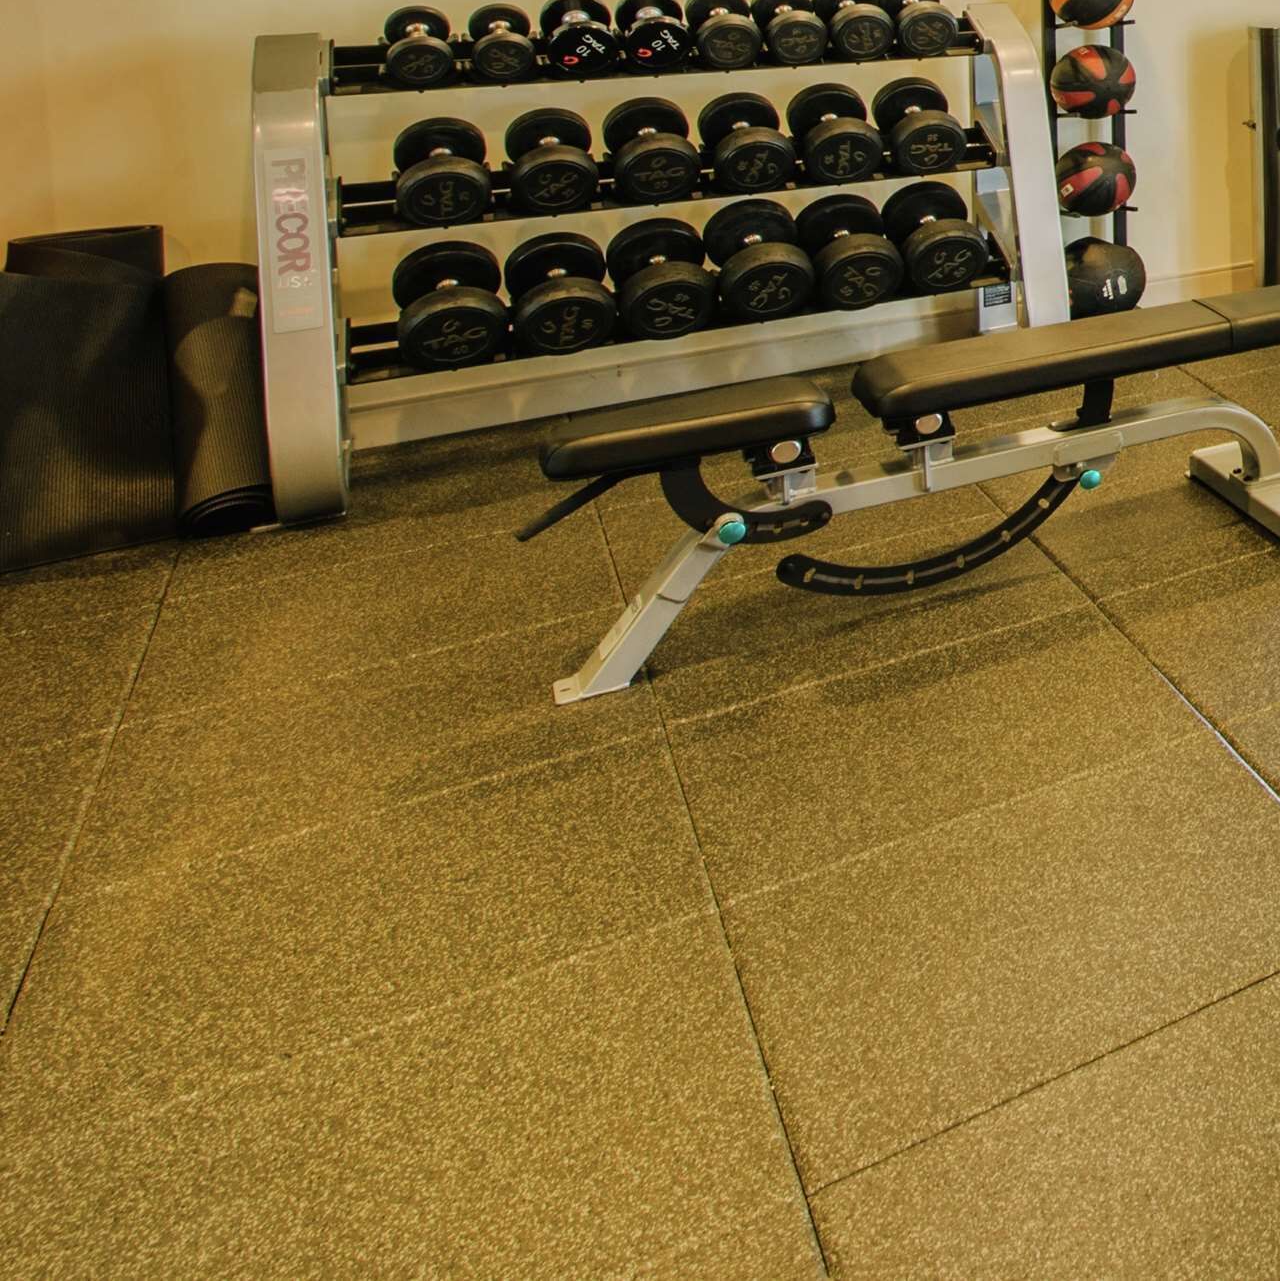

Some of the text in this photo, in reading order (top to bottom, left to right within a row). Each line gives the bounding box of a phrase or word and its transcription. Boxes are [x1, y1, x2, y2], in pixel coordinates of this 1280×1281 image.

[582, 34, 606, 54] TAG
[651, 39, 666, 51] 10
[660, 29, 681, 50] TAG
[576, 45, 592, 57] 10
[838, 141, 851, 175] TAG
[911, 142, 953, 155] TAG
[634, 169, 686, 184] TAG
[927, 249, 973, 280] TAG
[750, 272, 788, 308] TAG
[847, 266, 880, 298] TAG
[560, 306, 580, 346] TAG
[423, 326, 488, 350] TAG
